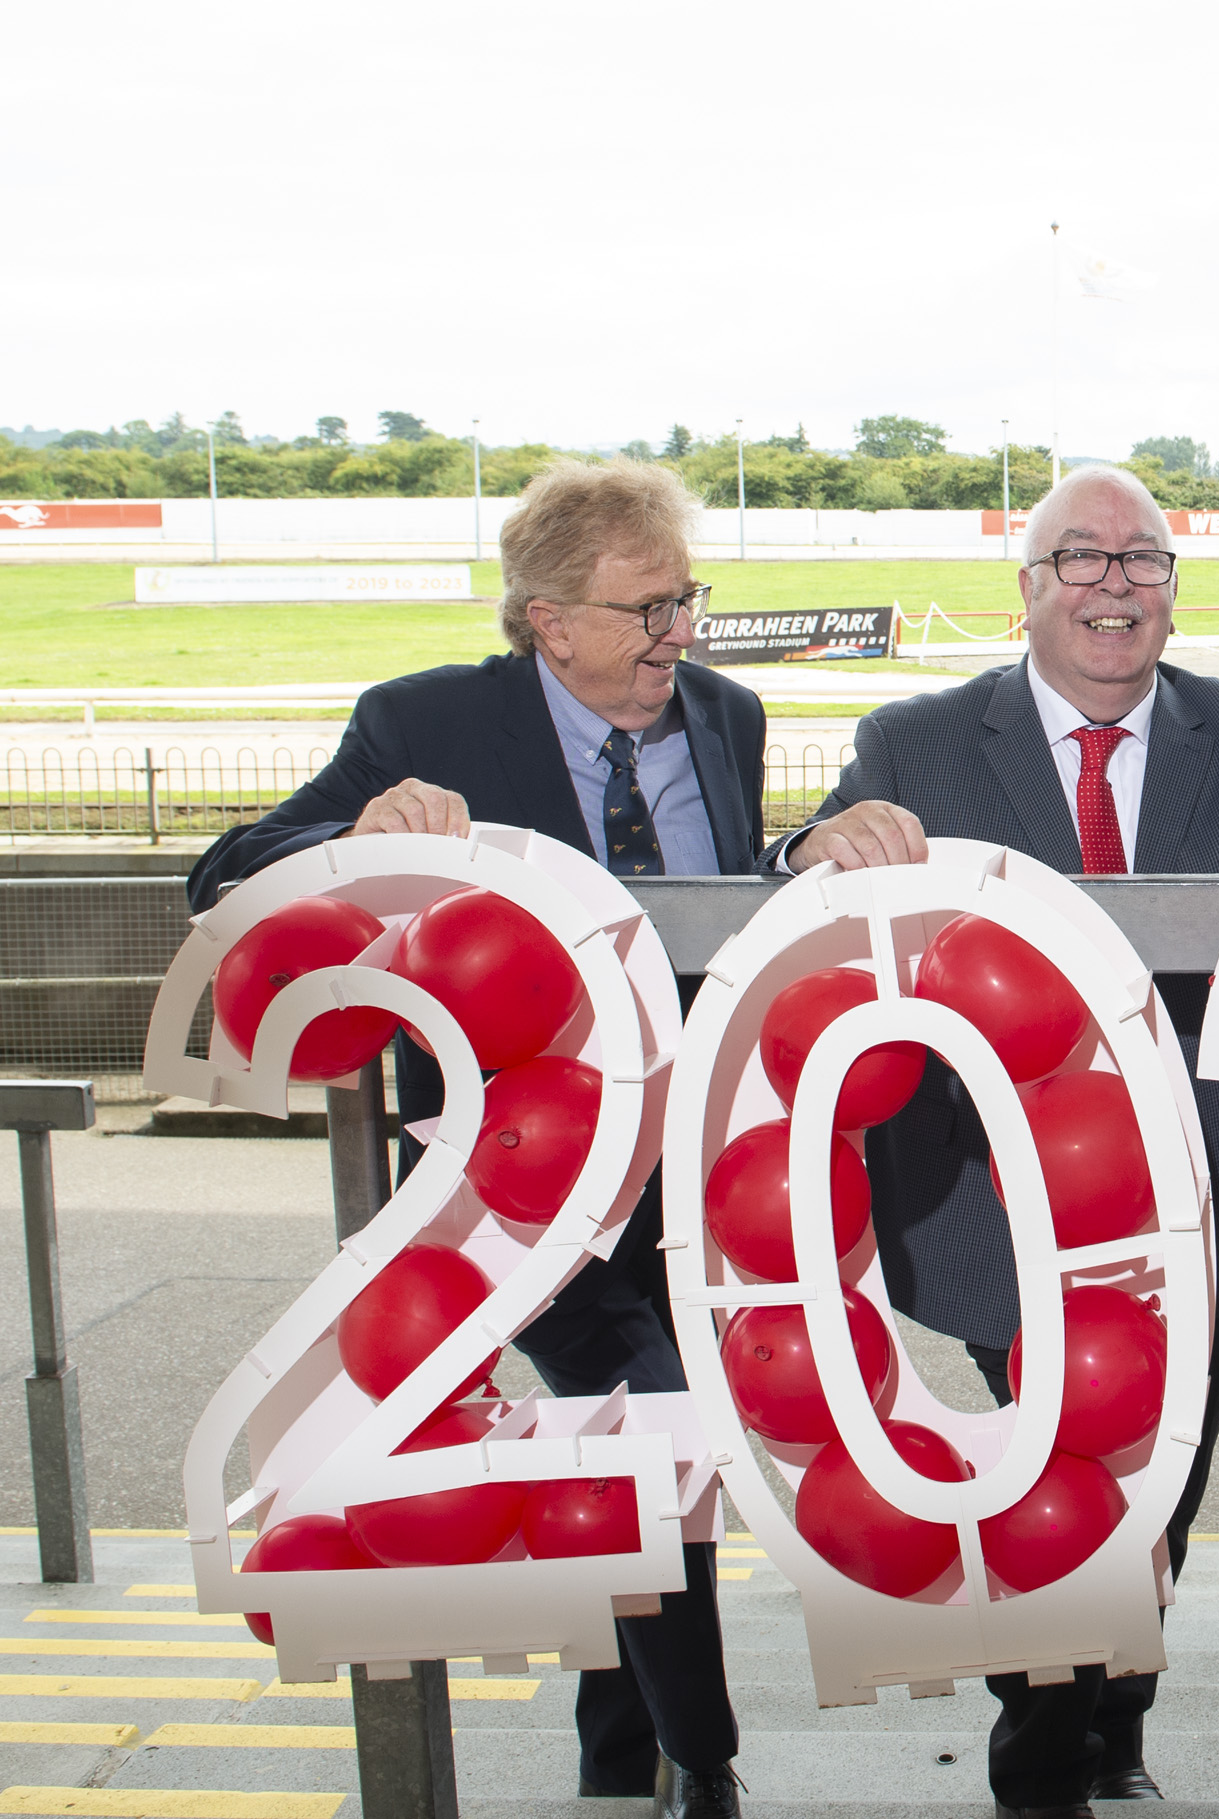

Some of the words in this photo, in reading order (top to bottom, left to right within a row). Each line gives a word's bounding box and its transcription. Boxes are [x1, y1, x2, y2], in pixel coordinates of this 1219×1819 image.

[346, 578, 389, 590] 2019
[395, 578, 413, 590] to
[420, 577, 463, 590] 2023
[695, 615, 818, 639] CURRAHEEN
[822, 612, 879, 632] PARK
[708, 639, 766, 651] GREYHOUND
[768, 638, 810, 649] STADIUM
